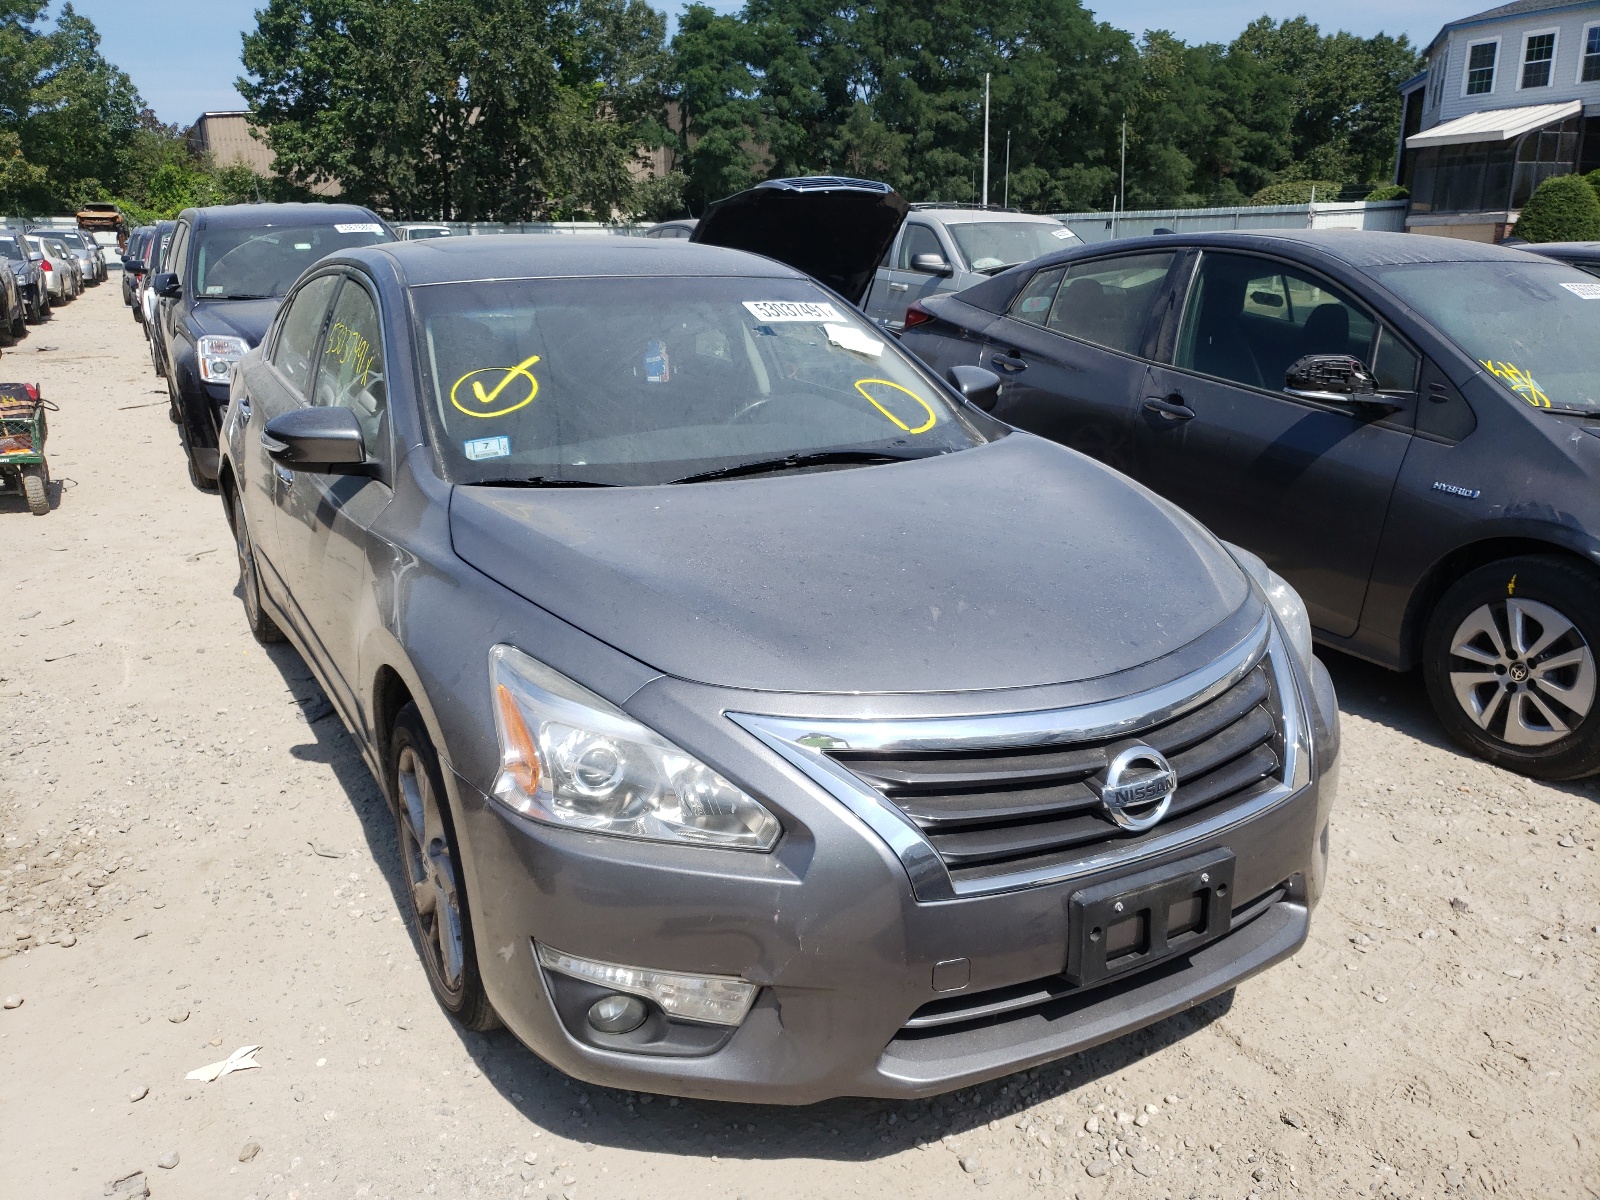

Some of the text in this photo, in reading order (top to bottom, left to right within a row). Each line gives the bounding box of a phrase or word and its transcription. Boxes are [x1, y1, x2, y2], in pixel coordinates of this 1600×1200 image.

[753, 302, 830, 318] 53037491
[482, 442, 489, 450] 7
[1432, 481, 1473, 497] HYBRID
[1115, 776, 1174, 805] NISSAN
